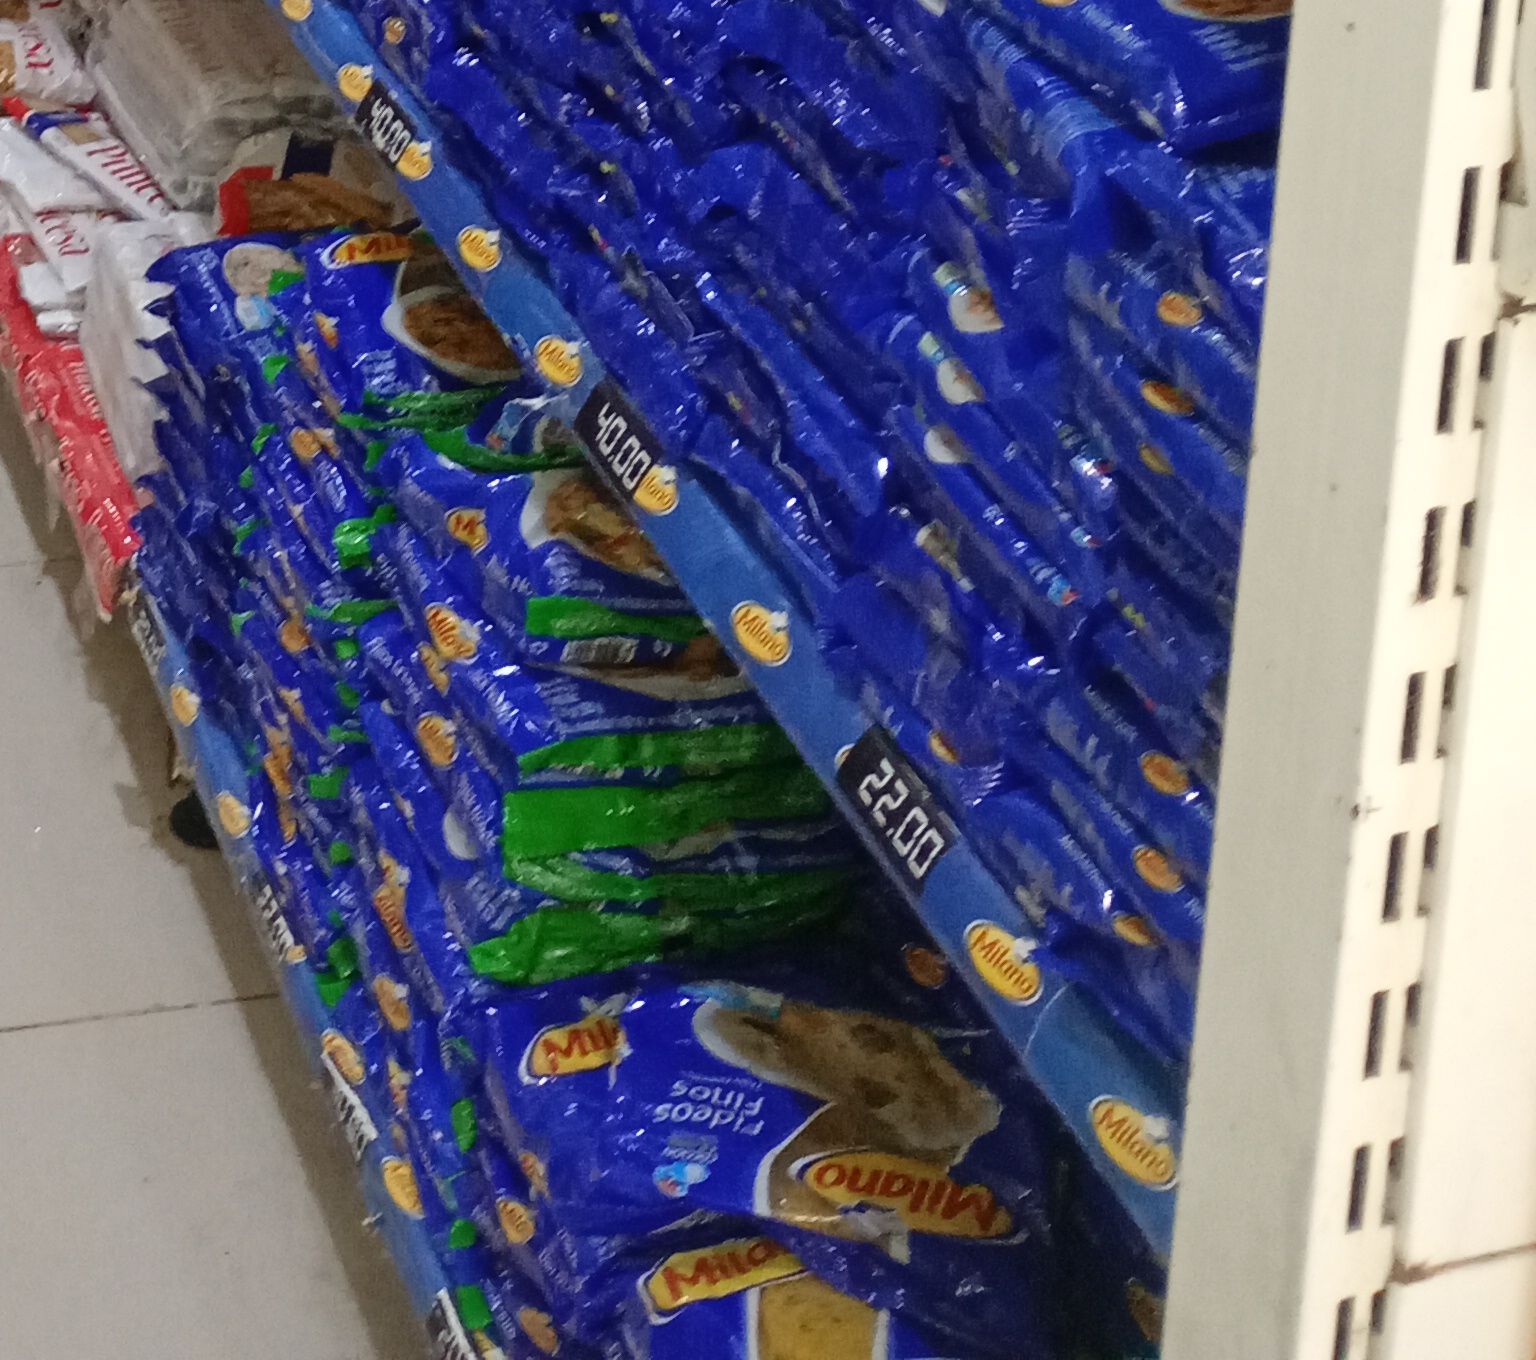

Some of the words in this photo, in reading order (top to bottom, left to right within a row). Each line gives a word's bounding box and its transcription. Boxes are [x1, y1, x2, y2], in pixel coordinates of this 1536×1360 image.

[370, 96, 414, 164] 40.00
[594, 401, 653, 491] 40.00
[736, 608, 786, 658] Milano
[859, 756, 946, 877] 22.00
[970, 928, 1035, 998] Milano
[655, 1100, 764, 1137] Fideos
[671, 1079, 764, 1114] Finos
[1098, 1105, 1175, 1174] Milano
[816, 1160, 996, 1233] Milano
